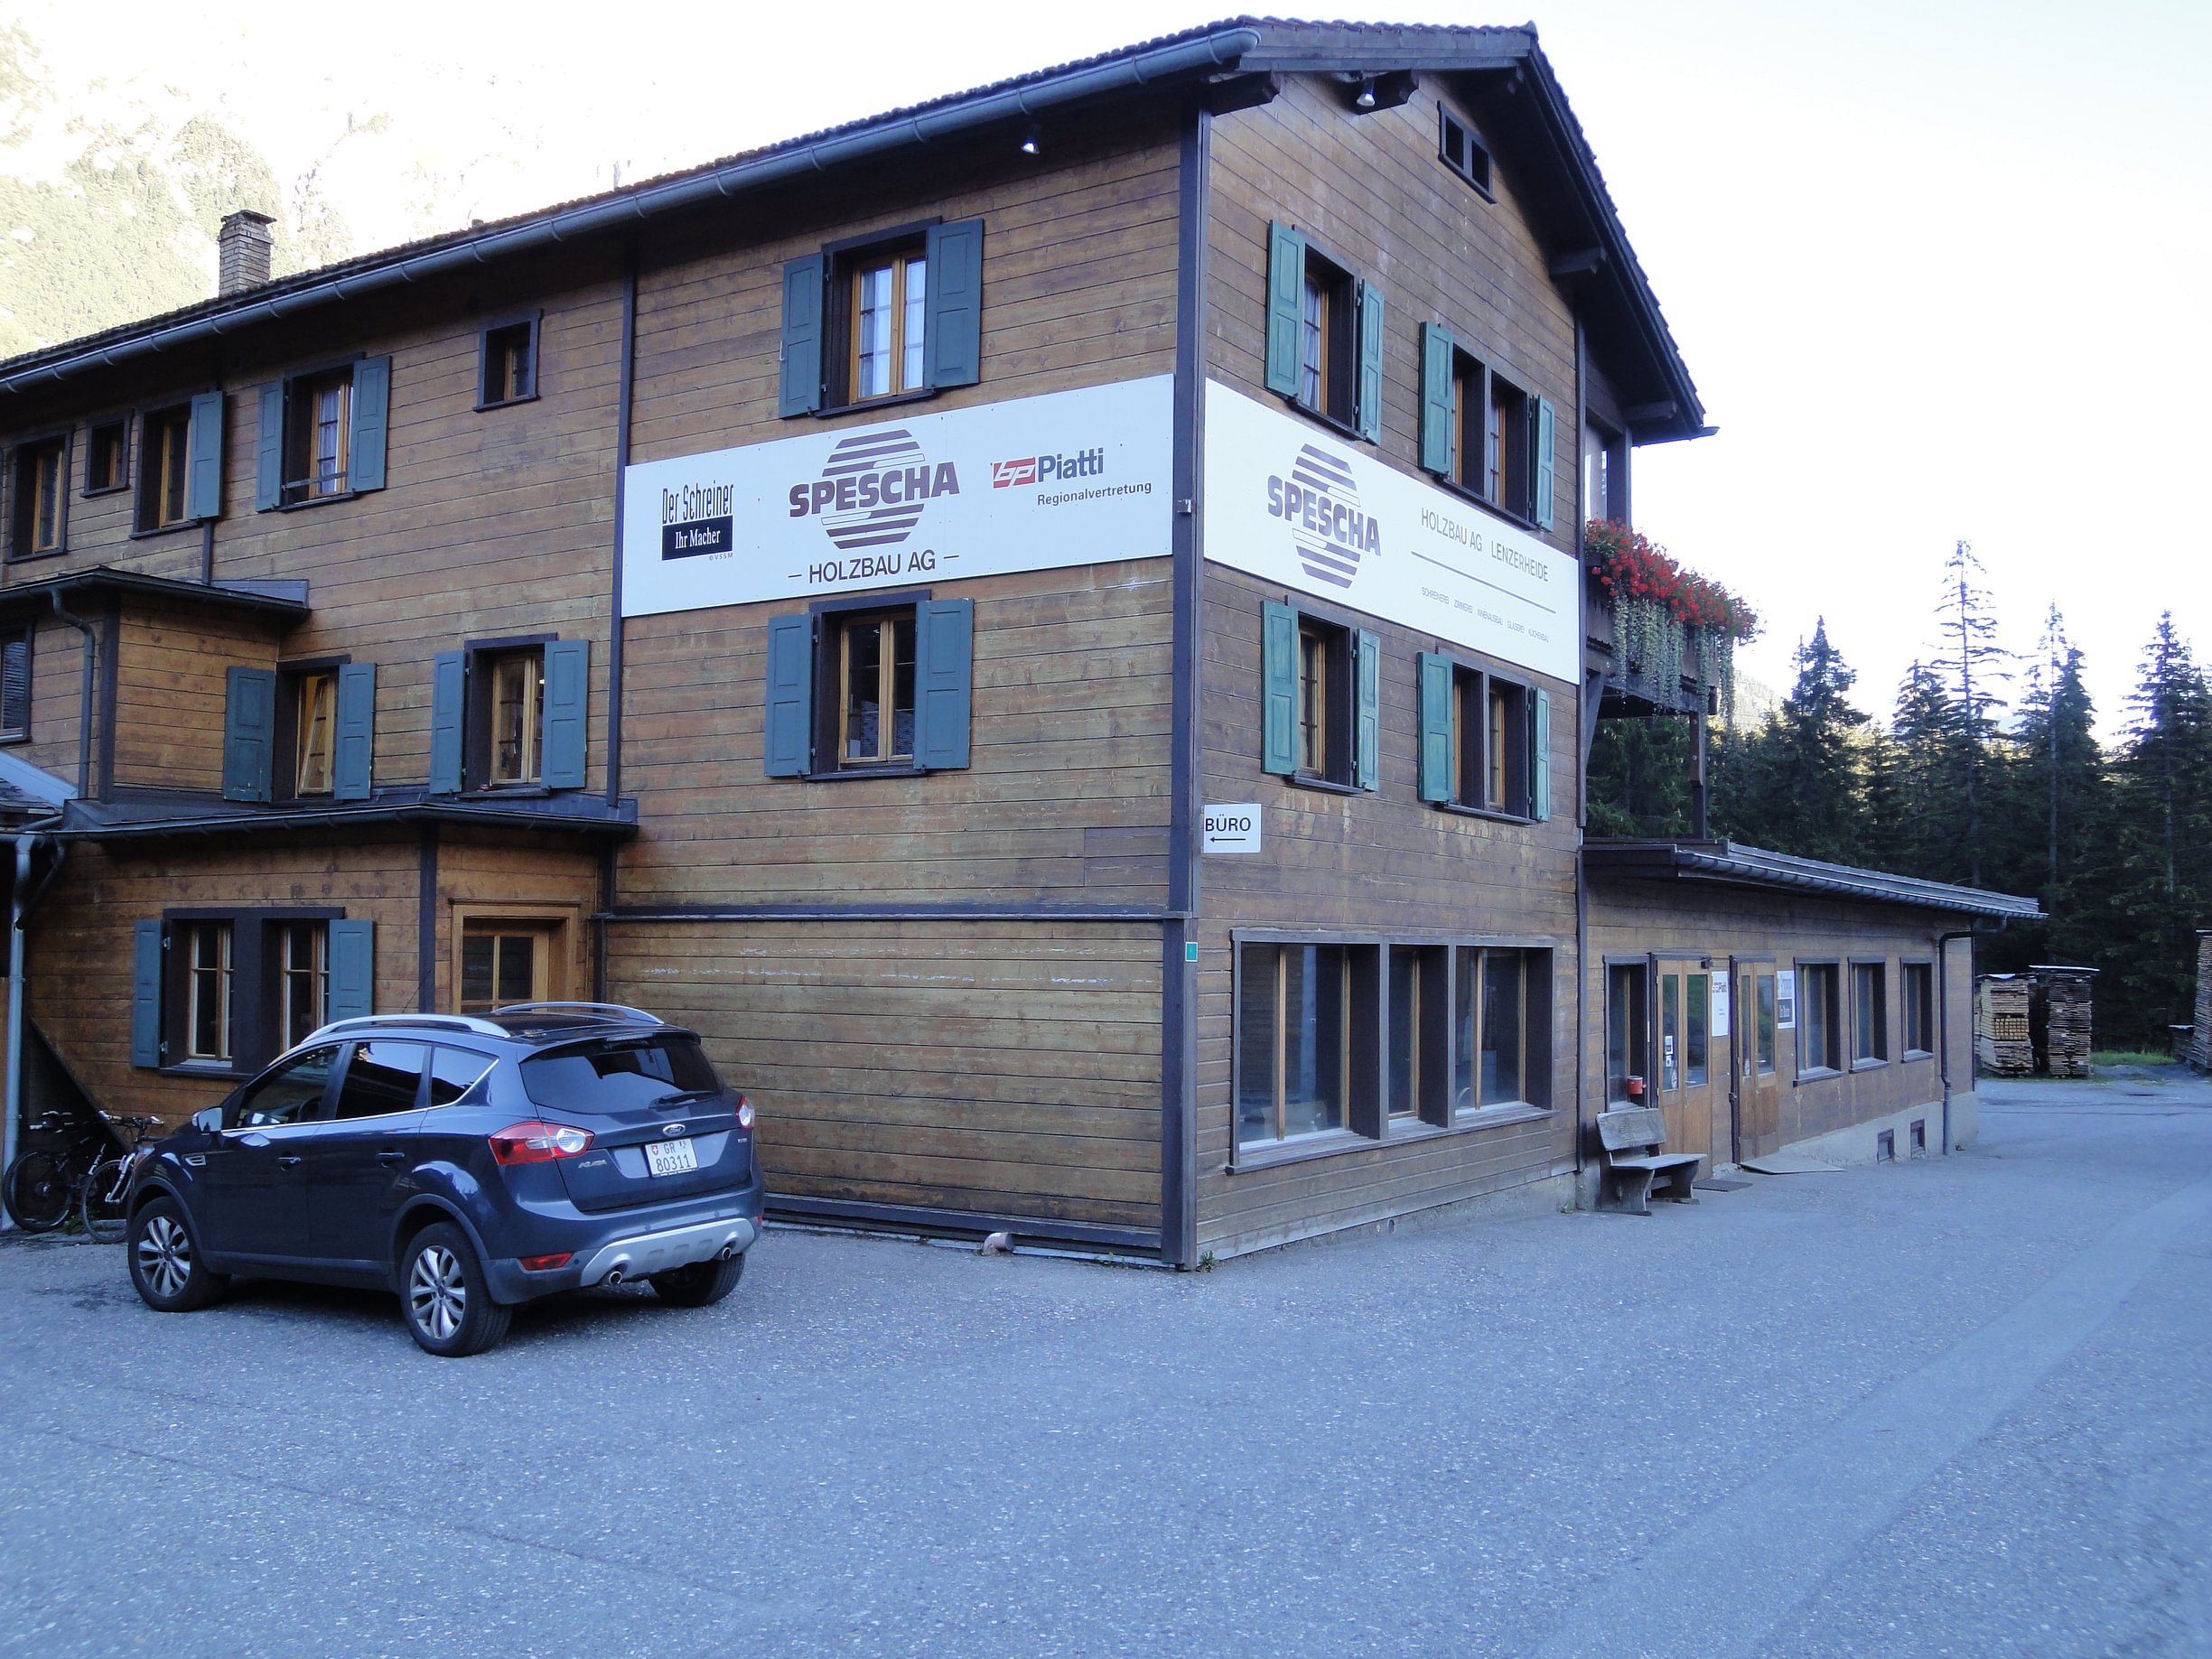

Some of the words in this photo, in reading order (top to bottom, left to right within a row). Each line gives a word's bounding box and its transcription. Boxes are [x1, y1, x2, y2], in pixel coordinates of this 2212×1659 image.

[1039, 447, 1104, 482] Piatti
[662, 488, 679, 524] Der
[683, 480, 733, 521] Schreiner
[789, 461, 960, 517] SPESCHA
[1038, 482, 1152, 506] Regionalvertretung
[1267, 474, 1381, 557] SPESCHA
[675, 530, 687, 549] Ihr
[689, 527, 721, 547] Macher
[1422, 507, 1468, 545] HOLZBAU
[1470, 531, 1482, 552] AG
[1490, 540, 1548, 583] LENZERHEIDE
[809, 554, 901, 583] HOLZBAU
[907, 549, 936, 573] AG
[1205, 814, 1252, 832] BÜRO
[657, 1154, 691, 1172] 80311
[664, 1142, 676, 1154] GR
